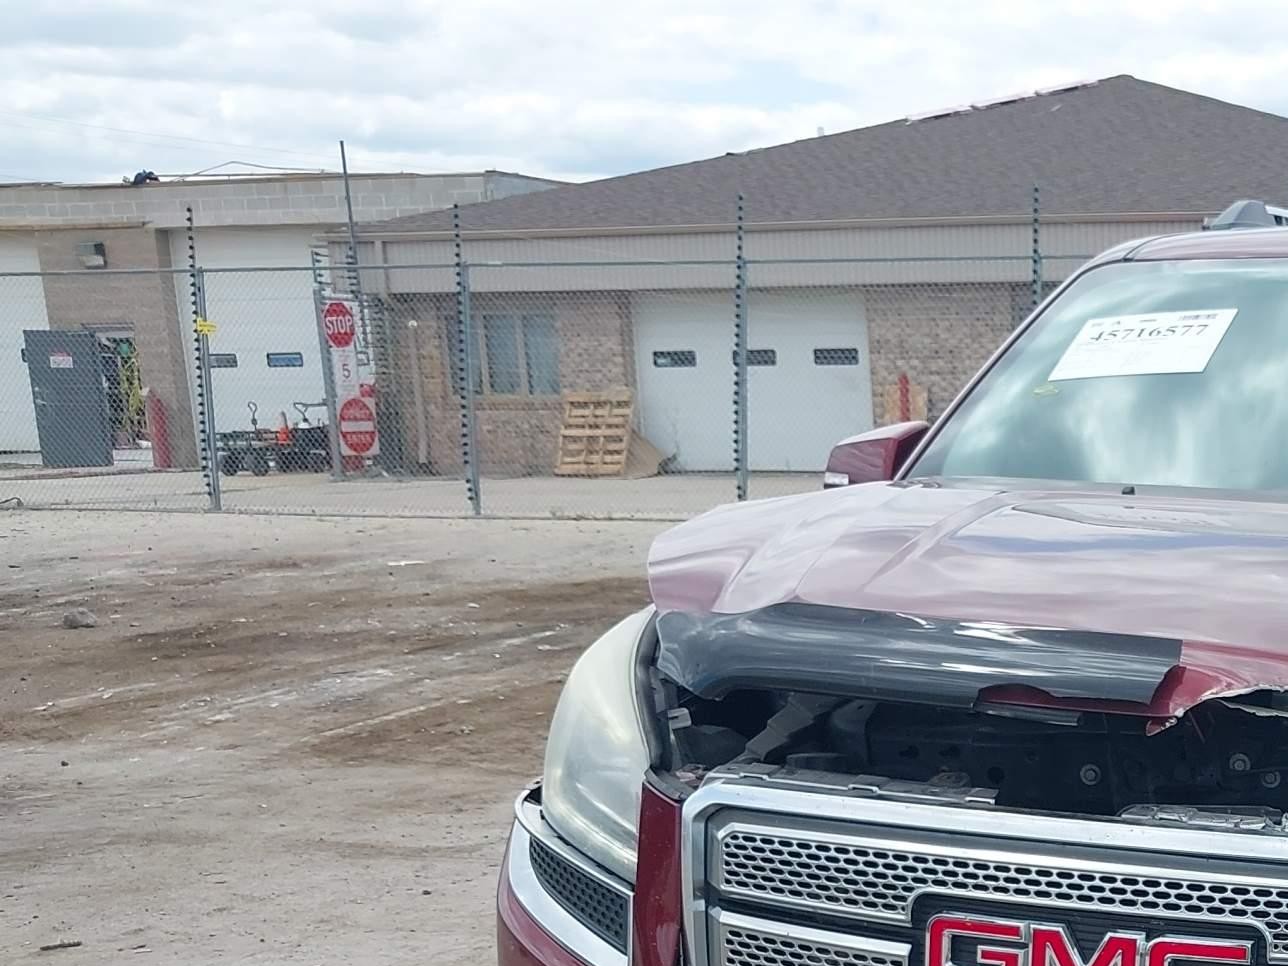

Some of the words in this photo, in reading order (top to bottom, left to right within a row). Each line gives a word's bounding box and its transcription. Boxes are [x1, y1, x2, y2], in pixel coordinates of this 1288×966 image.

[325, 315, 353, 335] STOP
[1089, 324, 1210, 342] 45716577
[342, 363, 351, 379] 5
